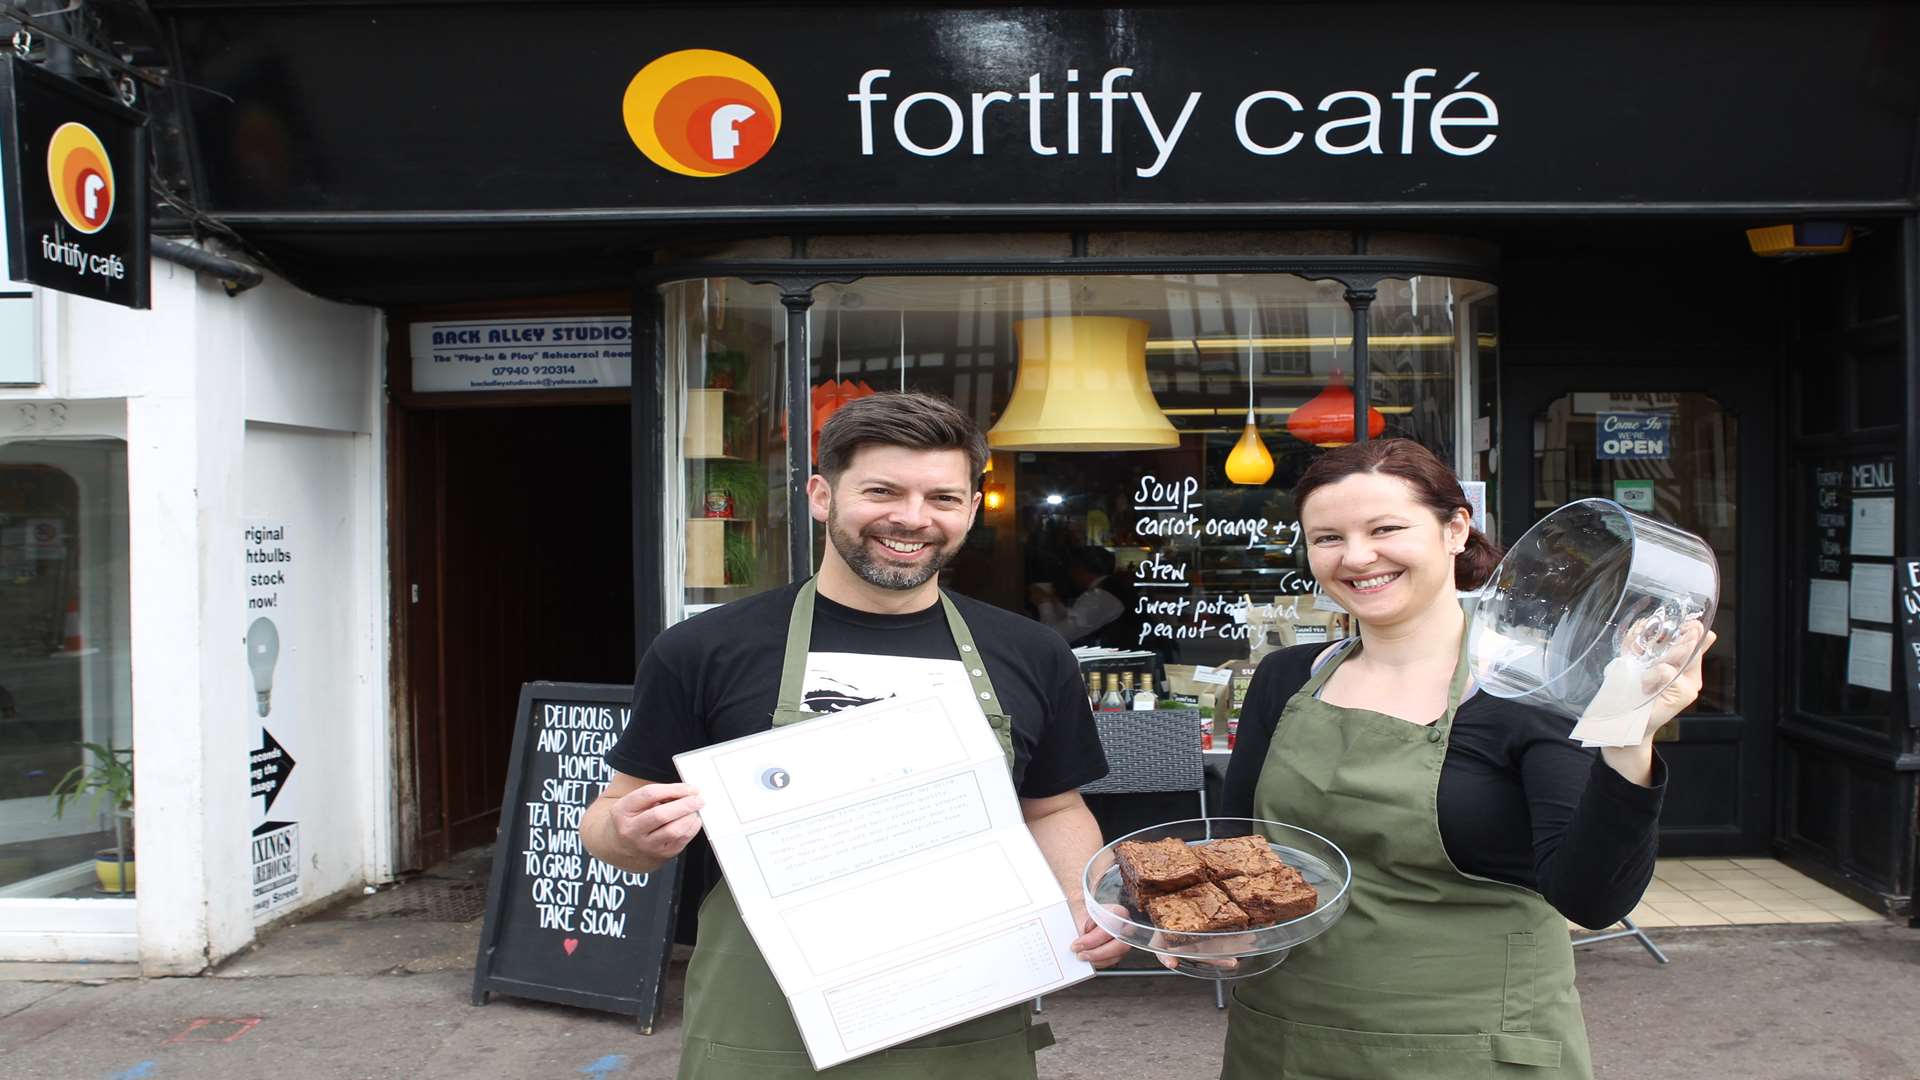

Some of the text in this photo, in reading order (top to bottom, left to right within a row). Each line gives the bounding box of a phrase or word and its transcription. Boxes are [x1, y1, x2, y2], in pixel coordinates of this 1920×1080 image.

[848, 68, 1499, 178] fortify café
[41, 234, 125, 280] fortify café
[431, 329, 481, 346] BACK
[488, 328, 545, 343] ALLEY
[433, 354, 452, 363] The
[498, 352, 507, 361] &
[511, 351, 539, 362] Play"
[542, 351, 599, 360] Rehearsal
[492, 364, 575, 376] 07940 920314
[1603, 415, 1663, 433] Come In
[1603, 439, 1664, 454] OPEN
[1851, 463, 1895, 489] MENU
[1135, 513, 1201, 539] carrot,
[1205, 517, 1268, 550] orange
[246, 547, 292, 563] htbulbs
[250, 570, 285, 586] stock
[248, 592, 278, 608] now!
[1262, 595, 1300, 620] and
[1138, 619, 1269, 650] peanut curry
[544, 704, 614, 730] DELICIOUS
[536, 729, 568, 753] AND
[558, 754, 616, 781] HOMEM
[541, 778, 592, 805] SWEET
[526, 802, 551, 828] TEA
[529, 827, 546, 852] IS
[522, 850, 541, 876] TO
[542, 853, 582, 880] GRAB
[586, 857, 622, 885] AND
[272, 887, 299, 903] Street
[532, 877, 626, 911] OR SIT AND
[536, 903, 627, 939] TAKE SLOW.
